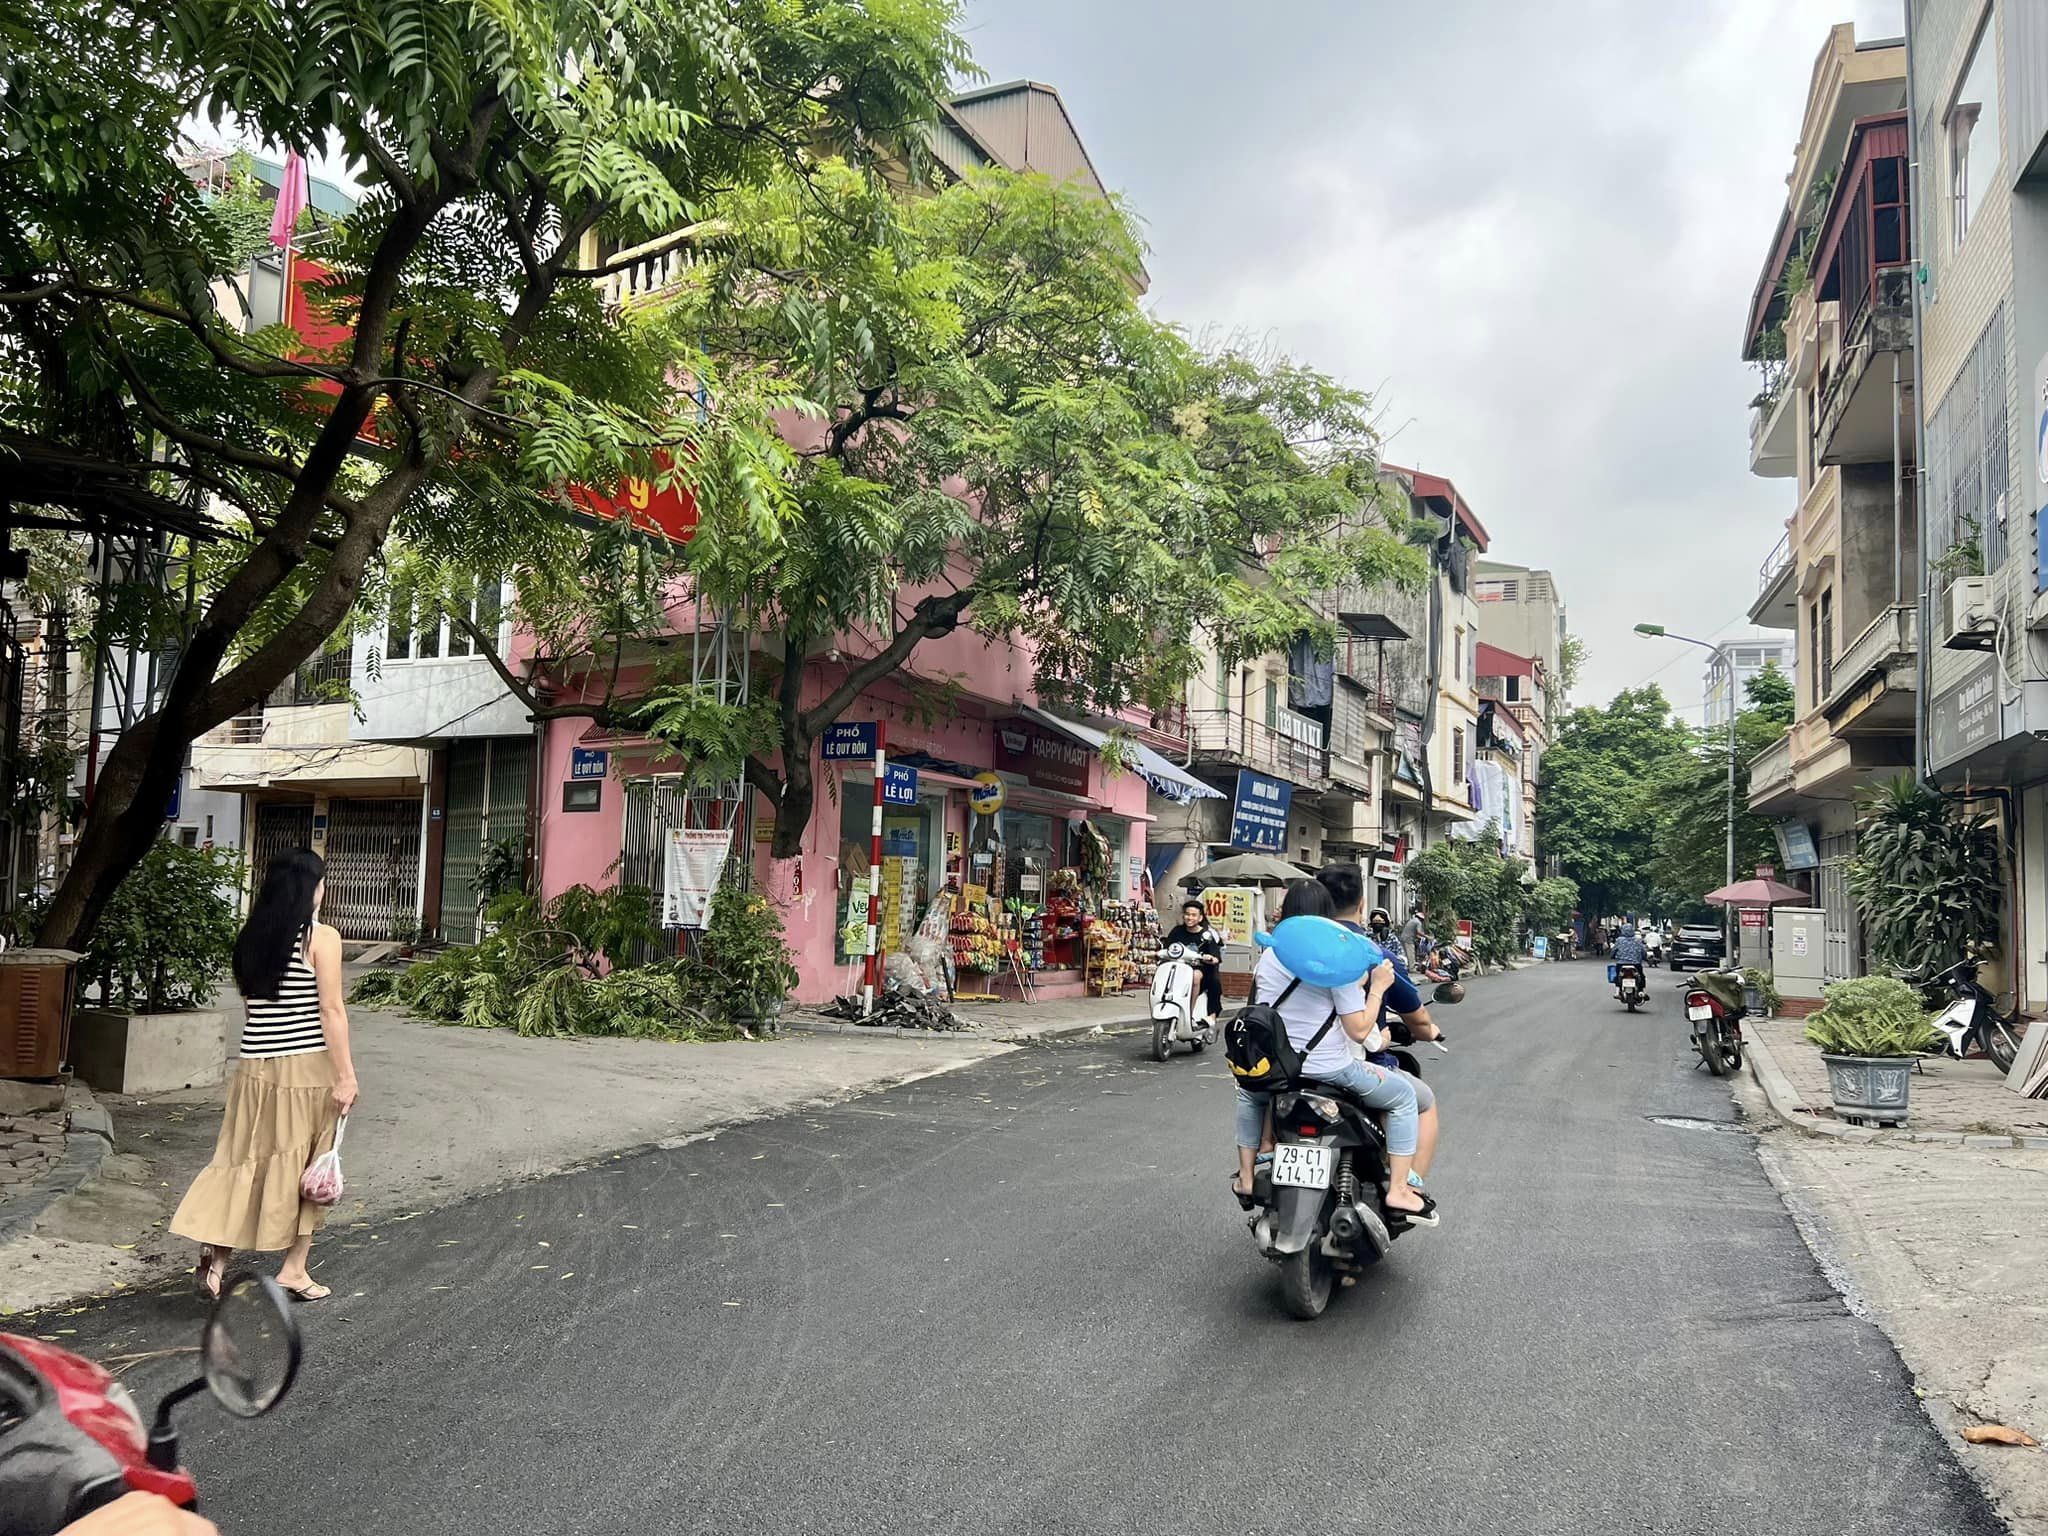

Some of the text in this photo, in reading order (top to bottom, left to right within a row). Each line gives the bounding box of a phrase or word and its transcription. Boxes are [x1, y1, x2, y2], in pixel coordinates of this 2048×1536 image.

[836, 723, 860, 737] PHỐ
[826, 741, 835, 755] LÊ
[1032, 737, 1062, 761] HAPPY
[1063, 746, 1087, 768] MART
[893, 768, 909, 781] PHỐ
[885, 783, 913, 802] LÊ LỢI
[1206, 893, 1226, 917] XÔI
[1276, 1165, 1325, 1185] 414.12
